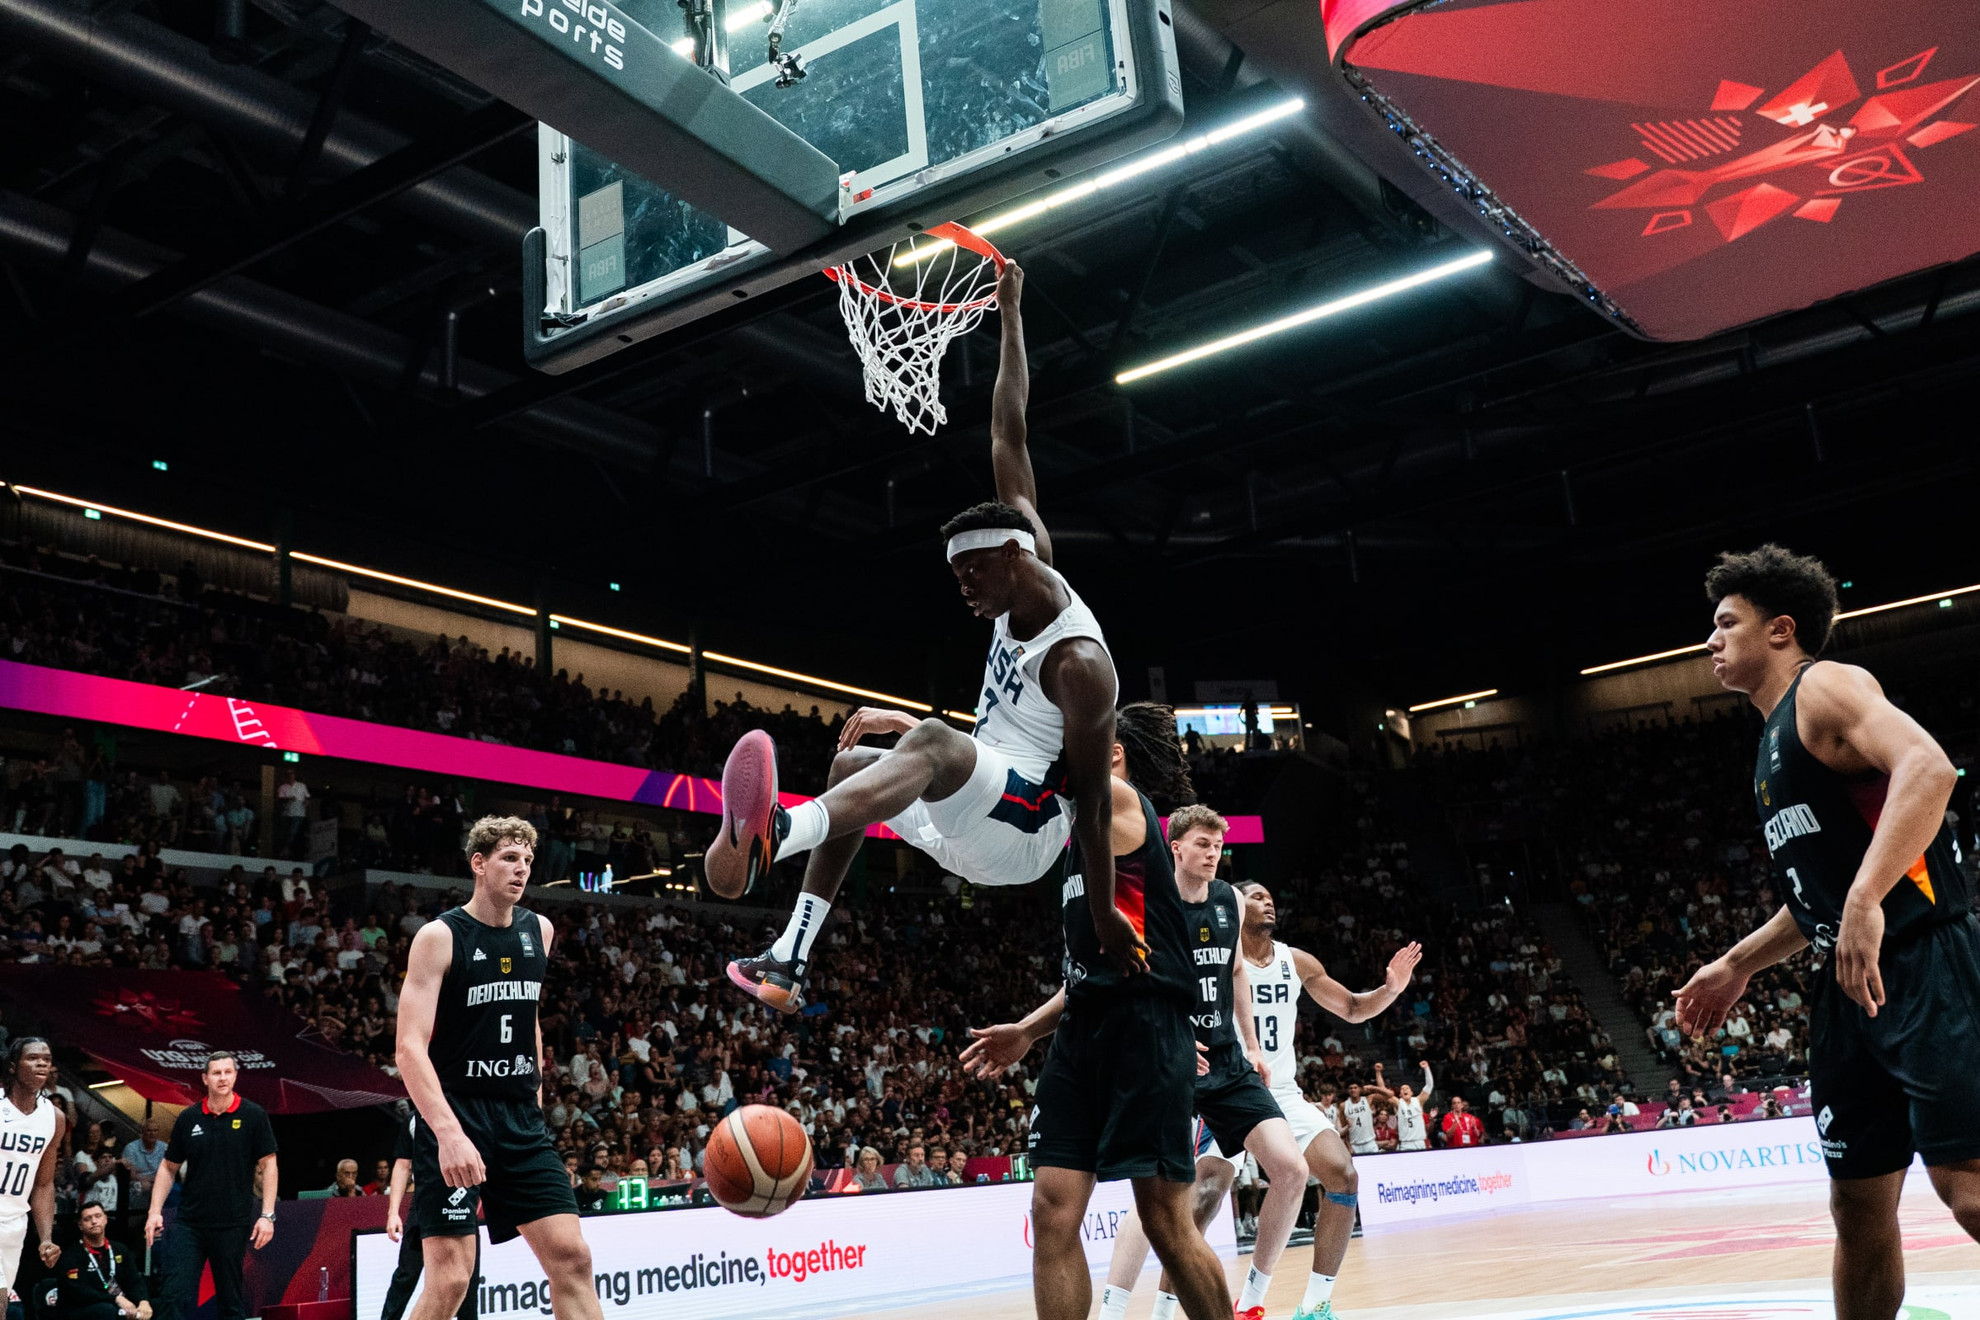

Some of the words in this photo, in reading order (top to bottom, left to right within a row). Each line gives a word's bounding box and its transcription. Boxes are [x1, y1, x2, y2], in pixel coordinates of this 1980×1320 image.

[1198, 976, 1218, 1002] 16
[500, 1014, 513, 1044] 6
[1189, 1014, 1214, 1029] NG
[1253, 1015, 1279, 1053] 13
[465, 1058, 511, 1078] ING
[1355, 1117, 1362, 1128] 4
[0, 1131, 46, 1155] USA
[1678, 1140, 1822, 1174] NOVARTIS
[0, 1161, 30, 1197] 10
[1377, 1178, 1438, 1205] Reimagining
[1438, 1174, 1481, 1196] medicine,
[1478, 1169, 1513, 1195] together
[636, 1250, 767, 1295] medicine,
[766, 1239, 867, 1283] together
